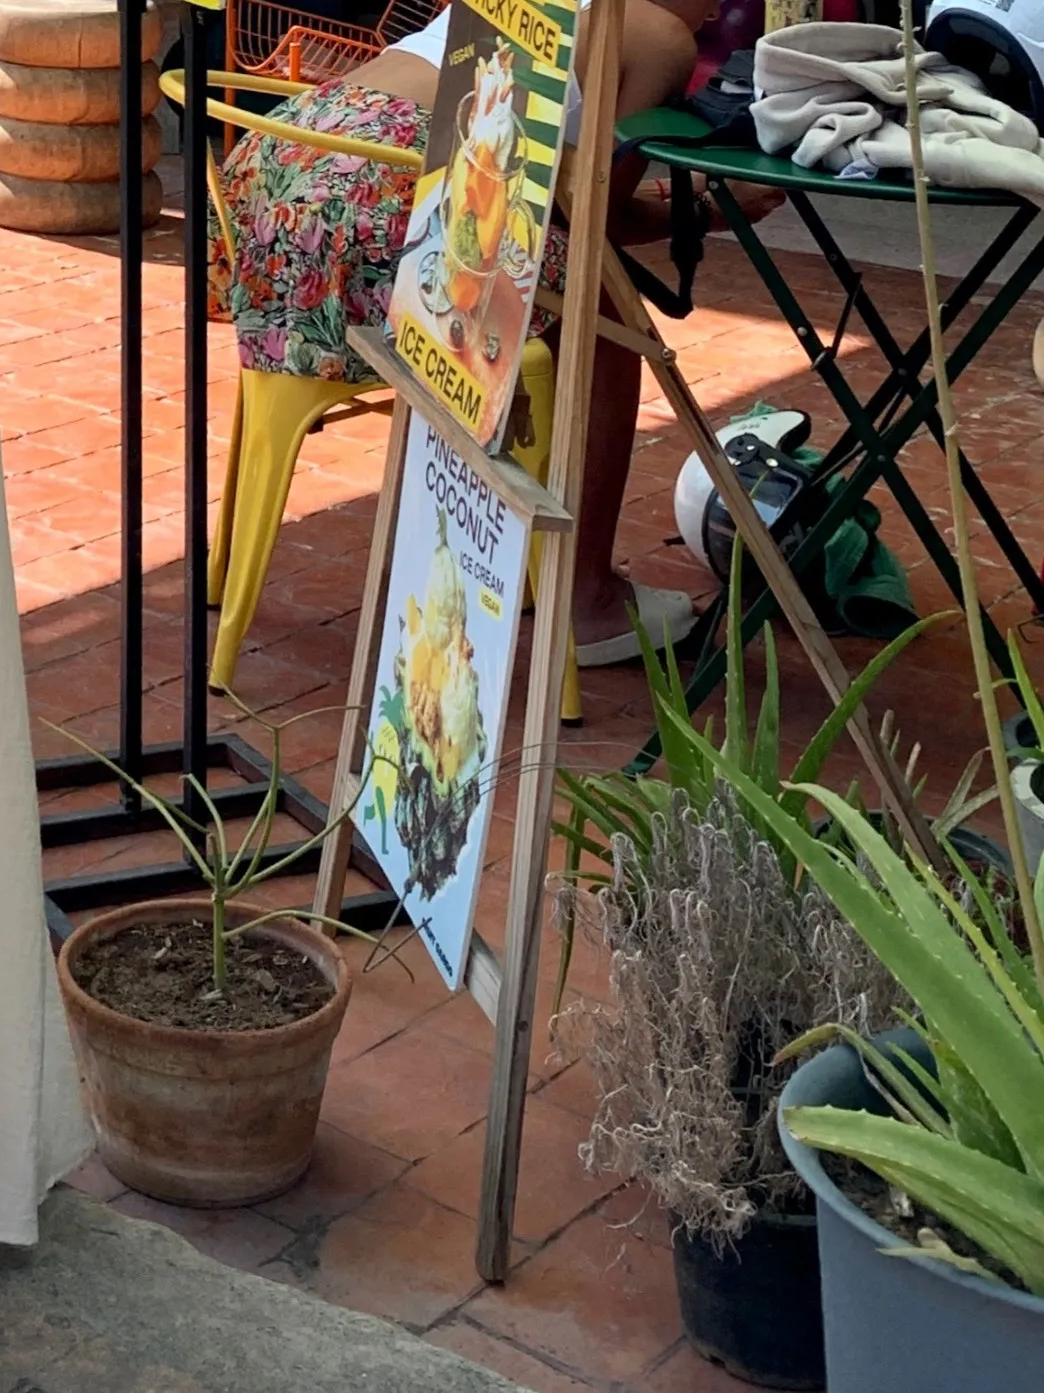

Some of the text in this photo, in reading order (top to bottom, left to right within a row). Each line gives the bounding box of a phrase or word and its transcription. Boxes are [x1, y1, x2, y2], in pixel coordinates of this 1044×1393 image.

[448, 42, 476, 67] VEGAN
[517, 8, 557, 61] RICE
[399, 320, 482, 425] ICE CREAM
[426, 425, 506, 535] PINEAPPLE
[425, 460, 499, 565] COCONUT
[459, 550, 505, 599] ICE CREAM
[480, 590, 501, 617] VEGAN
